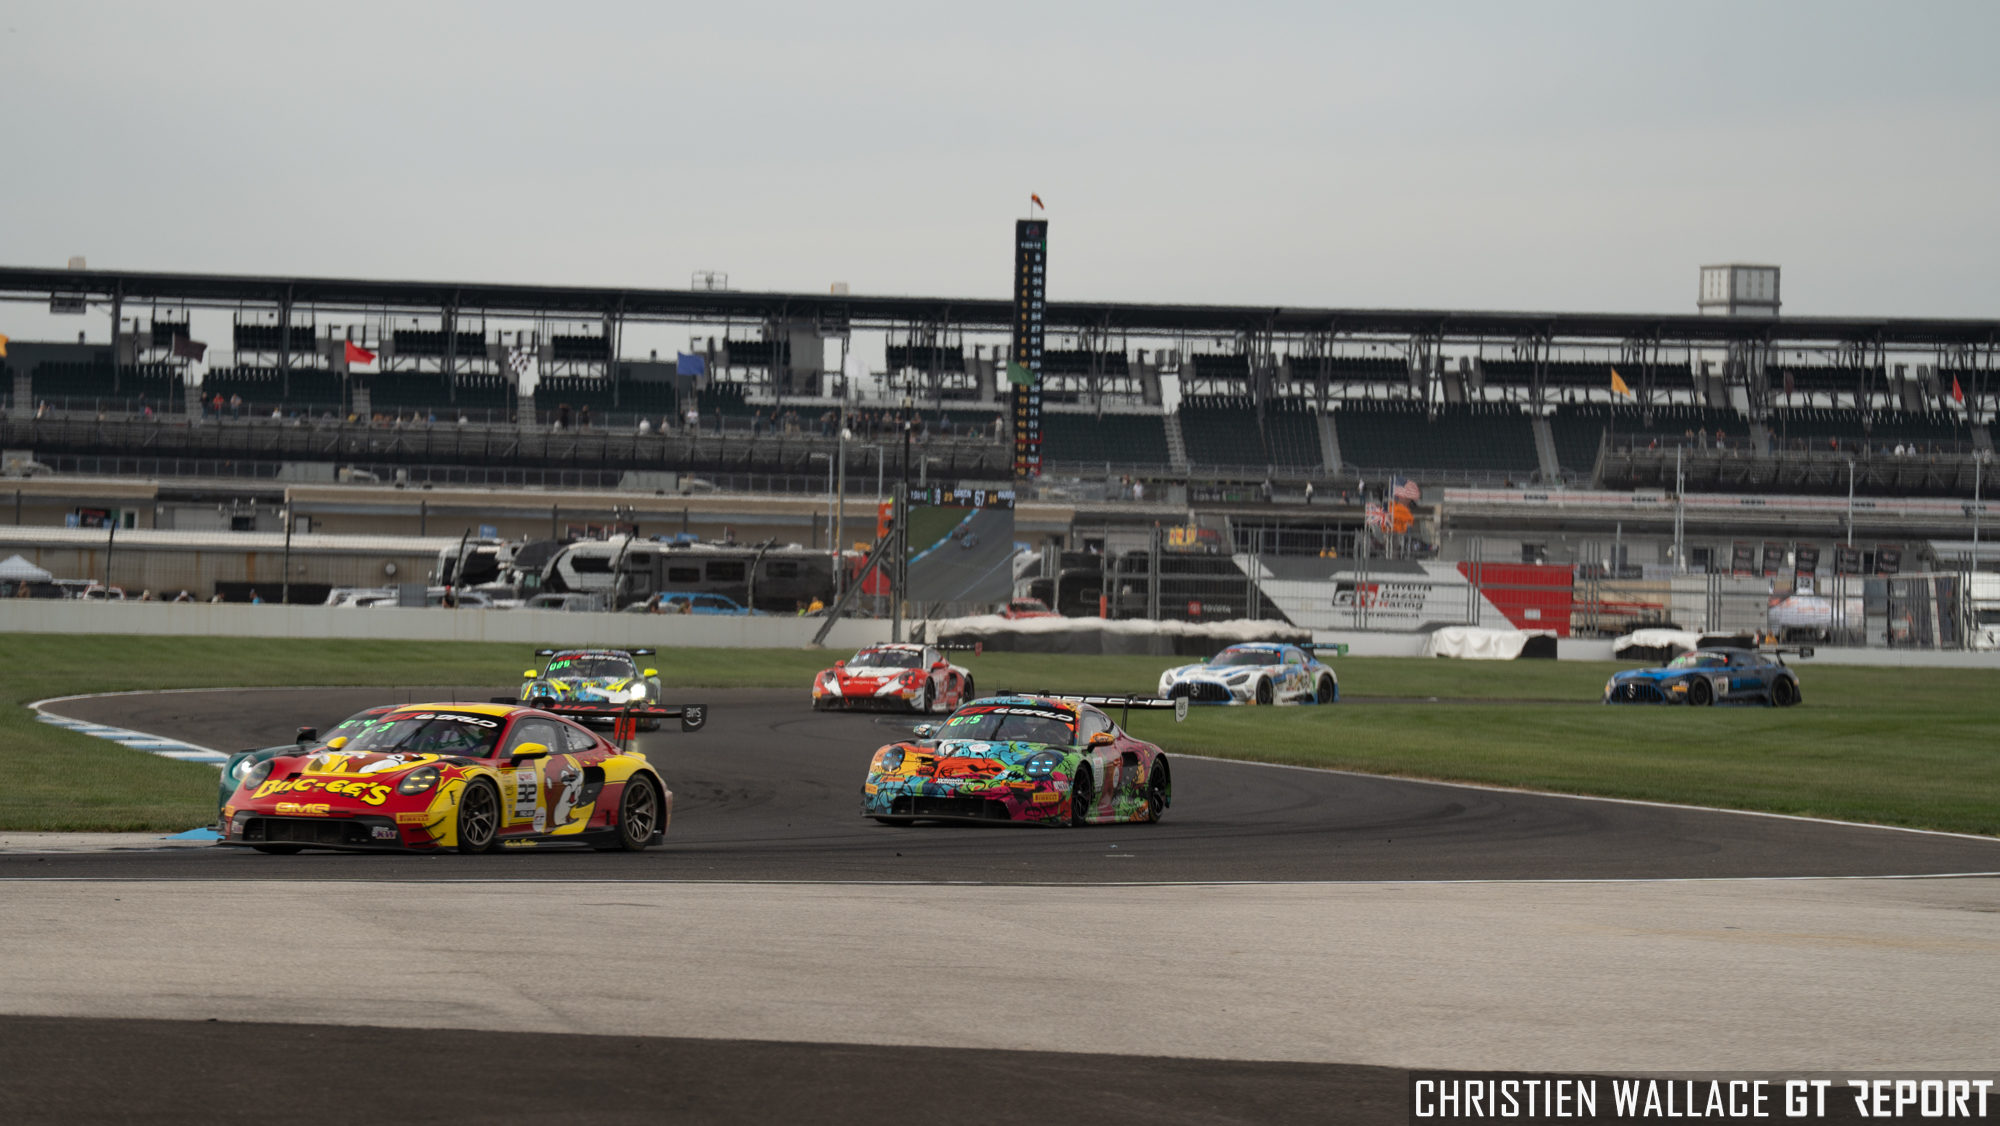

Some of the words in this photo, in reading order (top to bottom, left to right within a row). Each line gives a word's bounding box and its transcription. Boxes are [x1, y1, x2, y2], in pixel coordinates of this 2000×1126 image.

[686, 707, 702, 718] aws
[957, 706, 1010, 716] GT
[993, 708, 1074, 722] WORLD
[414, 713, 498, 728] WORLD
[517, 784, 537, 803] 32
[275, 802, 330, 814] GMG
